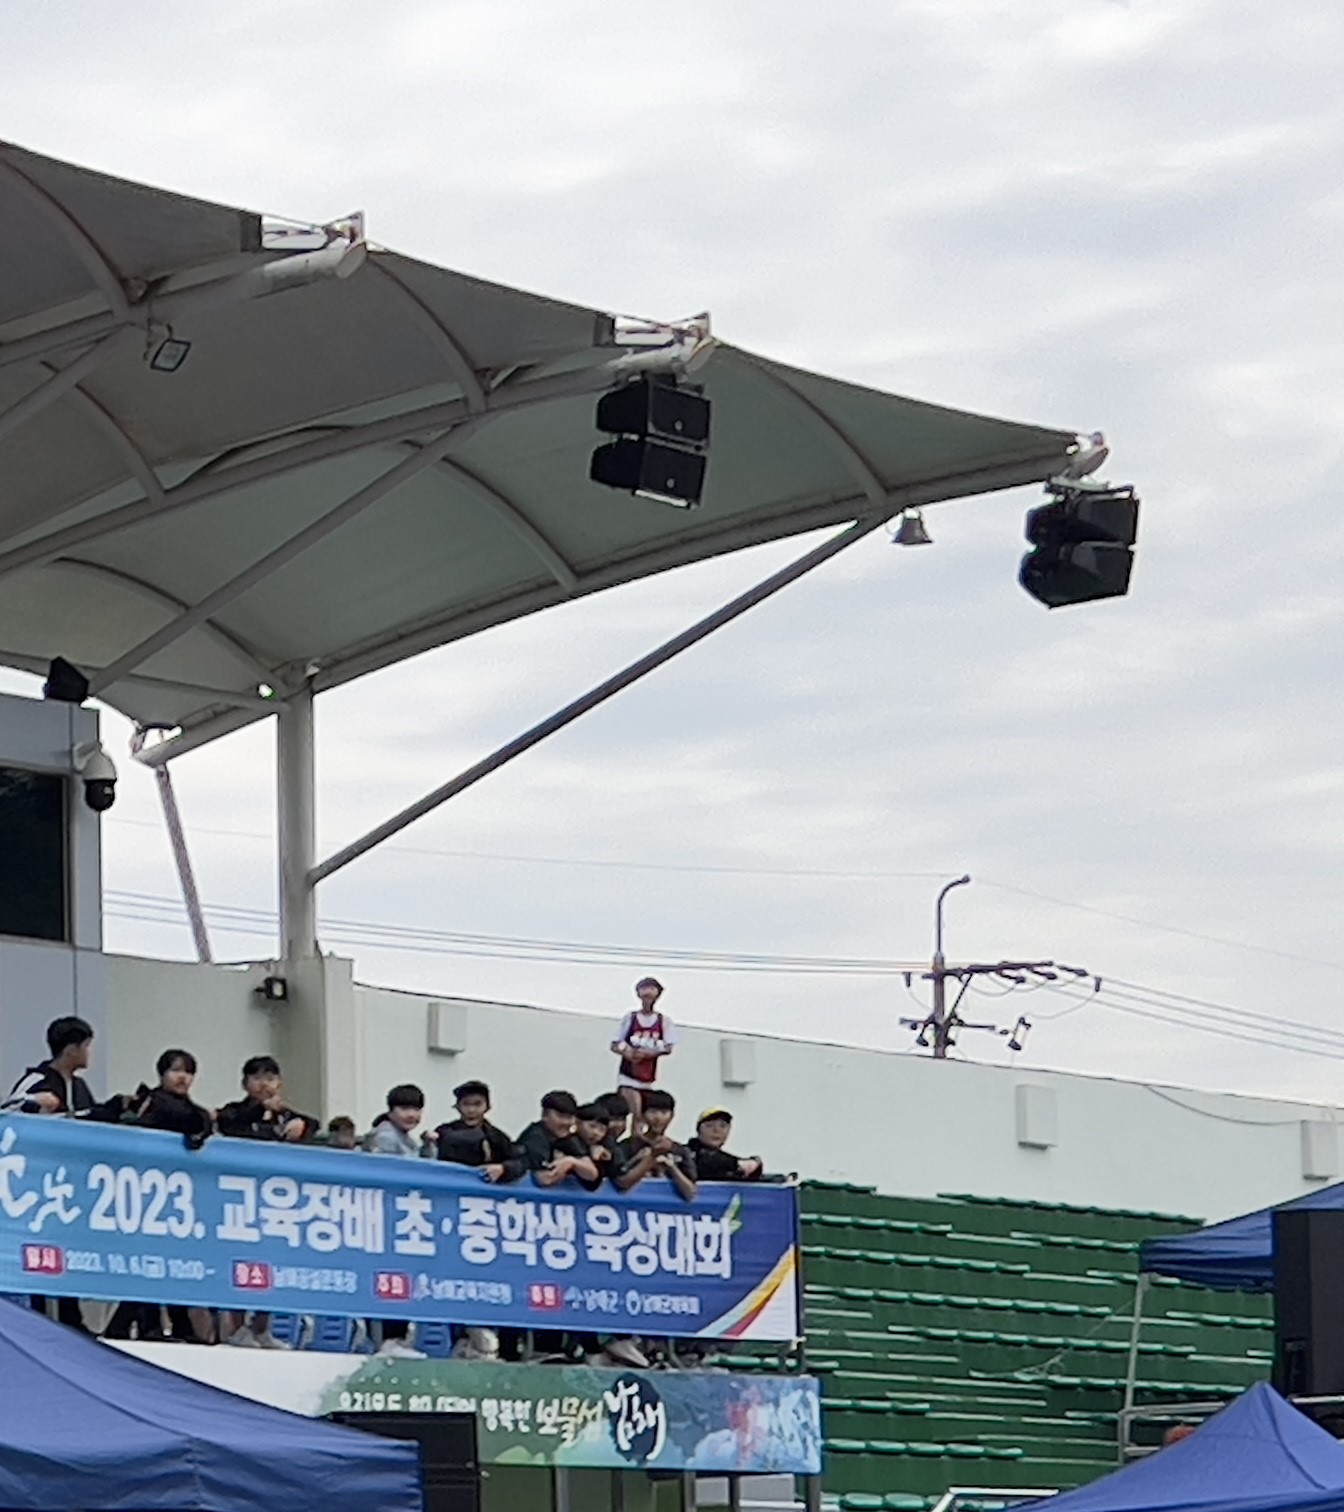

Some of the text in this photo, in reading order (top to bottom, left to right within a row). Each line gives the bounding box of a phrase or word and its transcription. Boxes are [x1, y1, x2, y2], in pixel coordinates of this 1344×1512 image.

[87, 1163, 205, 1239] 2023.
[216, 1175, 385, 1254] 교육장배
[584, 1204, 733, 1279] 육상대회
